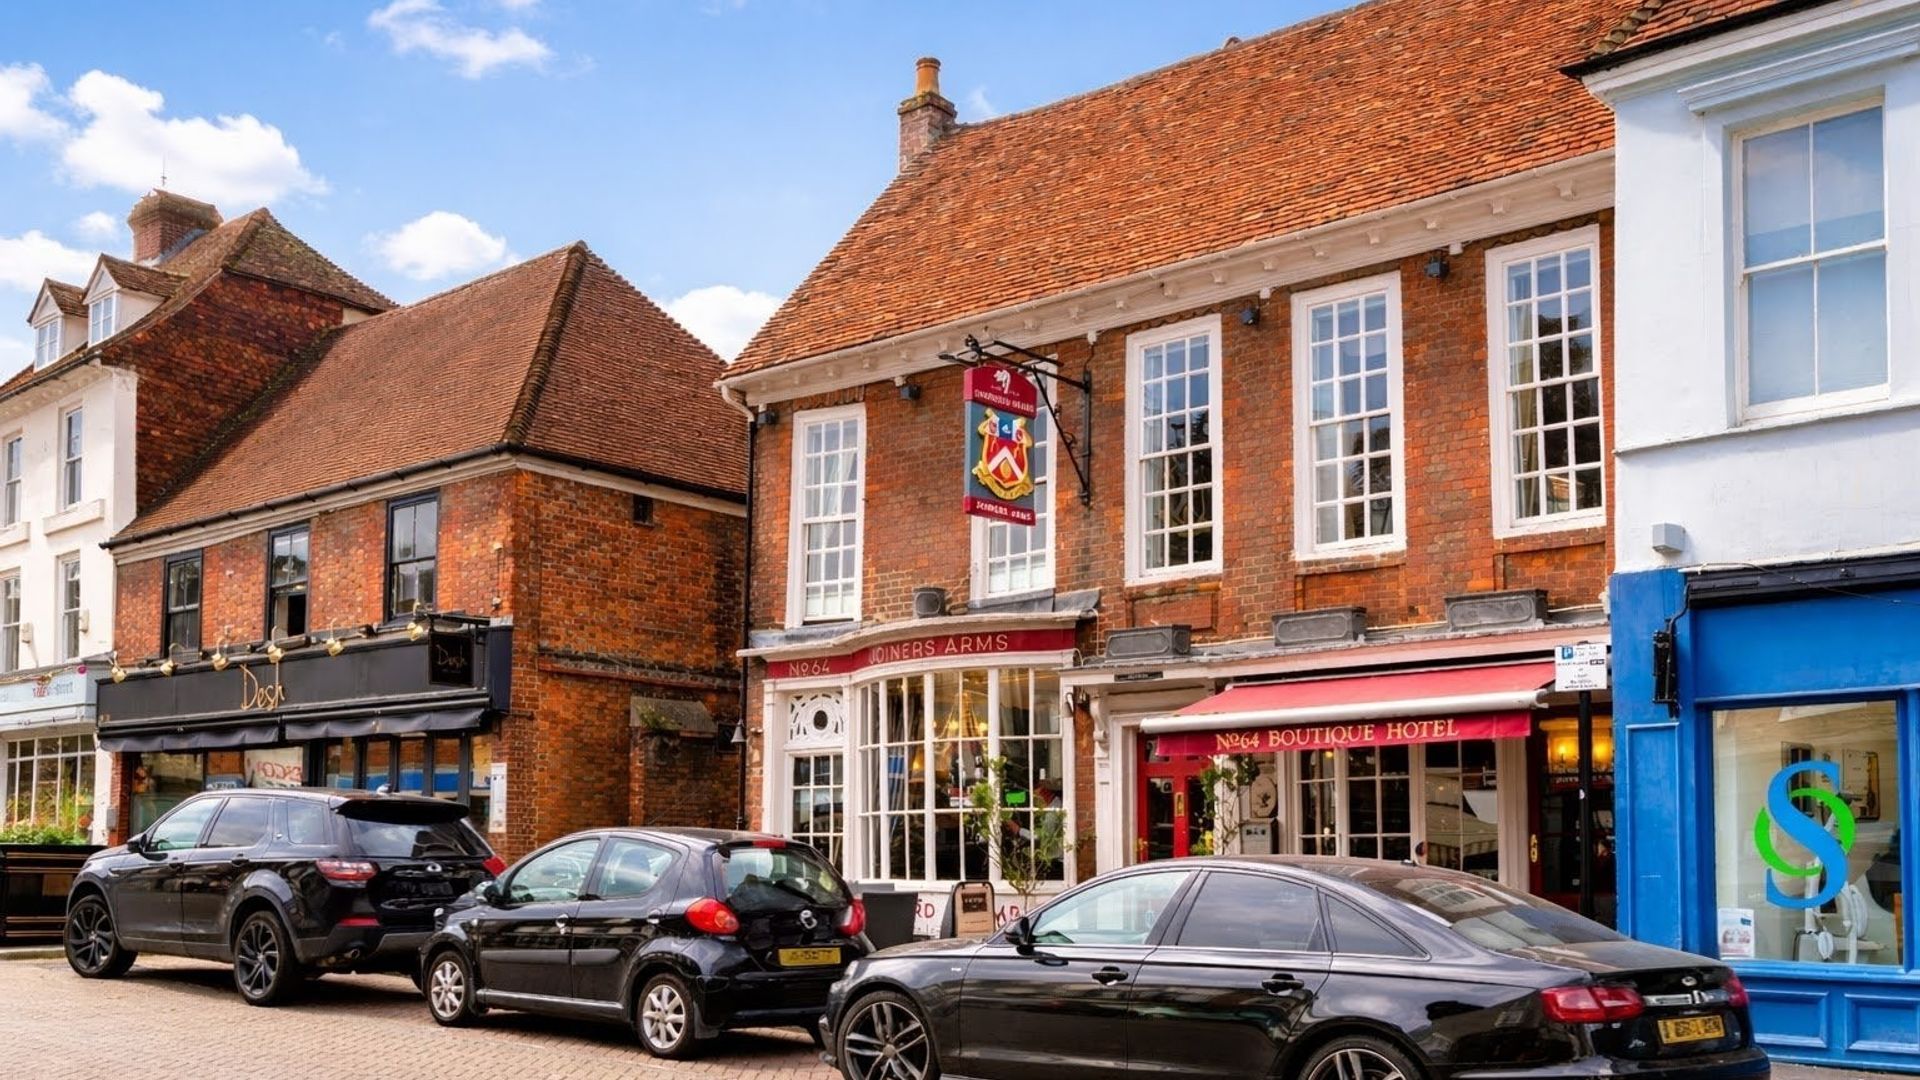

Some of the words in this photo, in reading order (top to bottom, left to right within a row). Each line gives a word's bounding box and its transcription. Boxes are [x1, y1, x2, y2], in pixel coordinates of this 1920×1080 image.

[869, 640, 935, 665] JOINERS
[945, 634, 1008, 654] ARMS
[1268, 724, 1375, 747] BOUTIQUE
[1386, 719, 1460, 740] HOTEL
